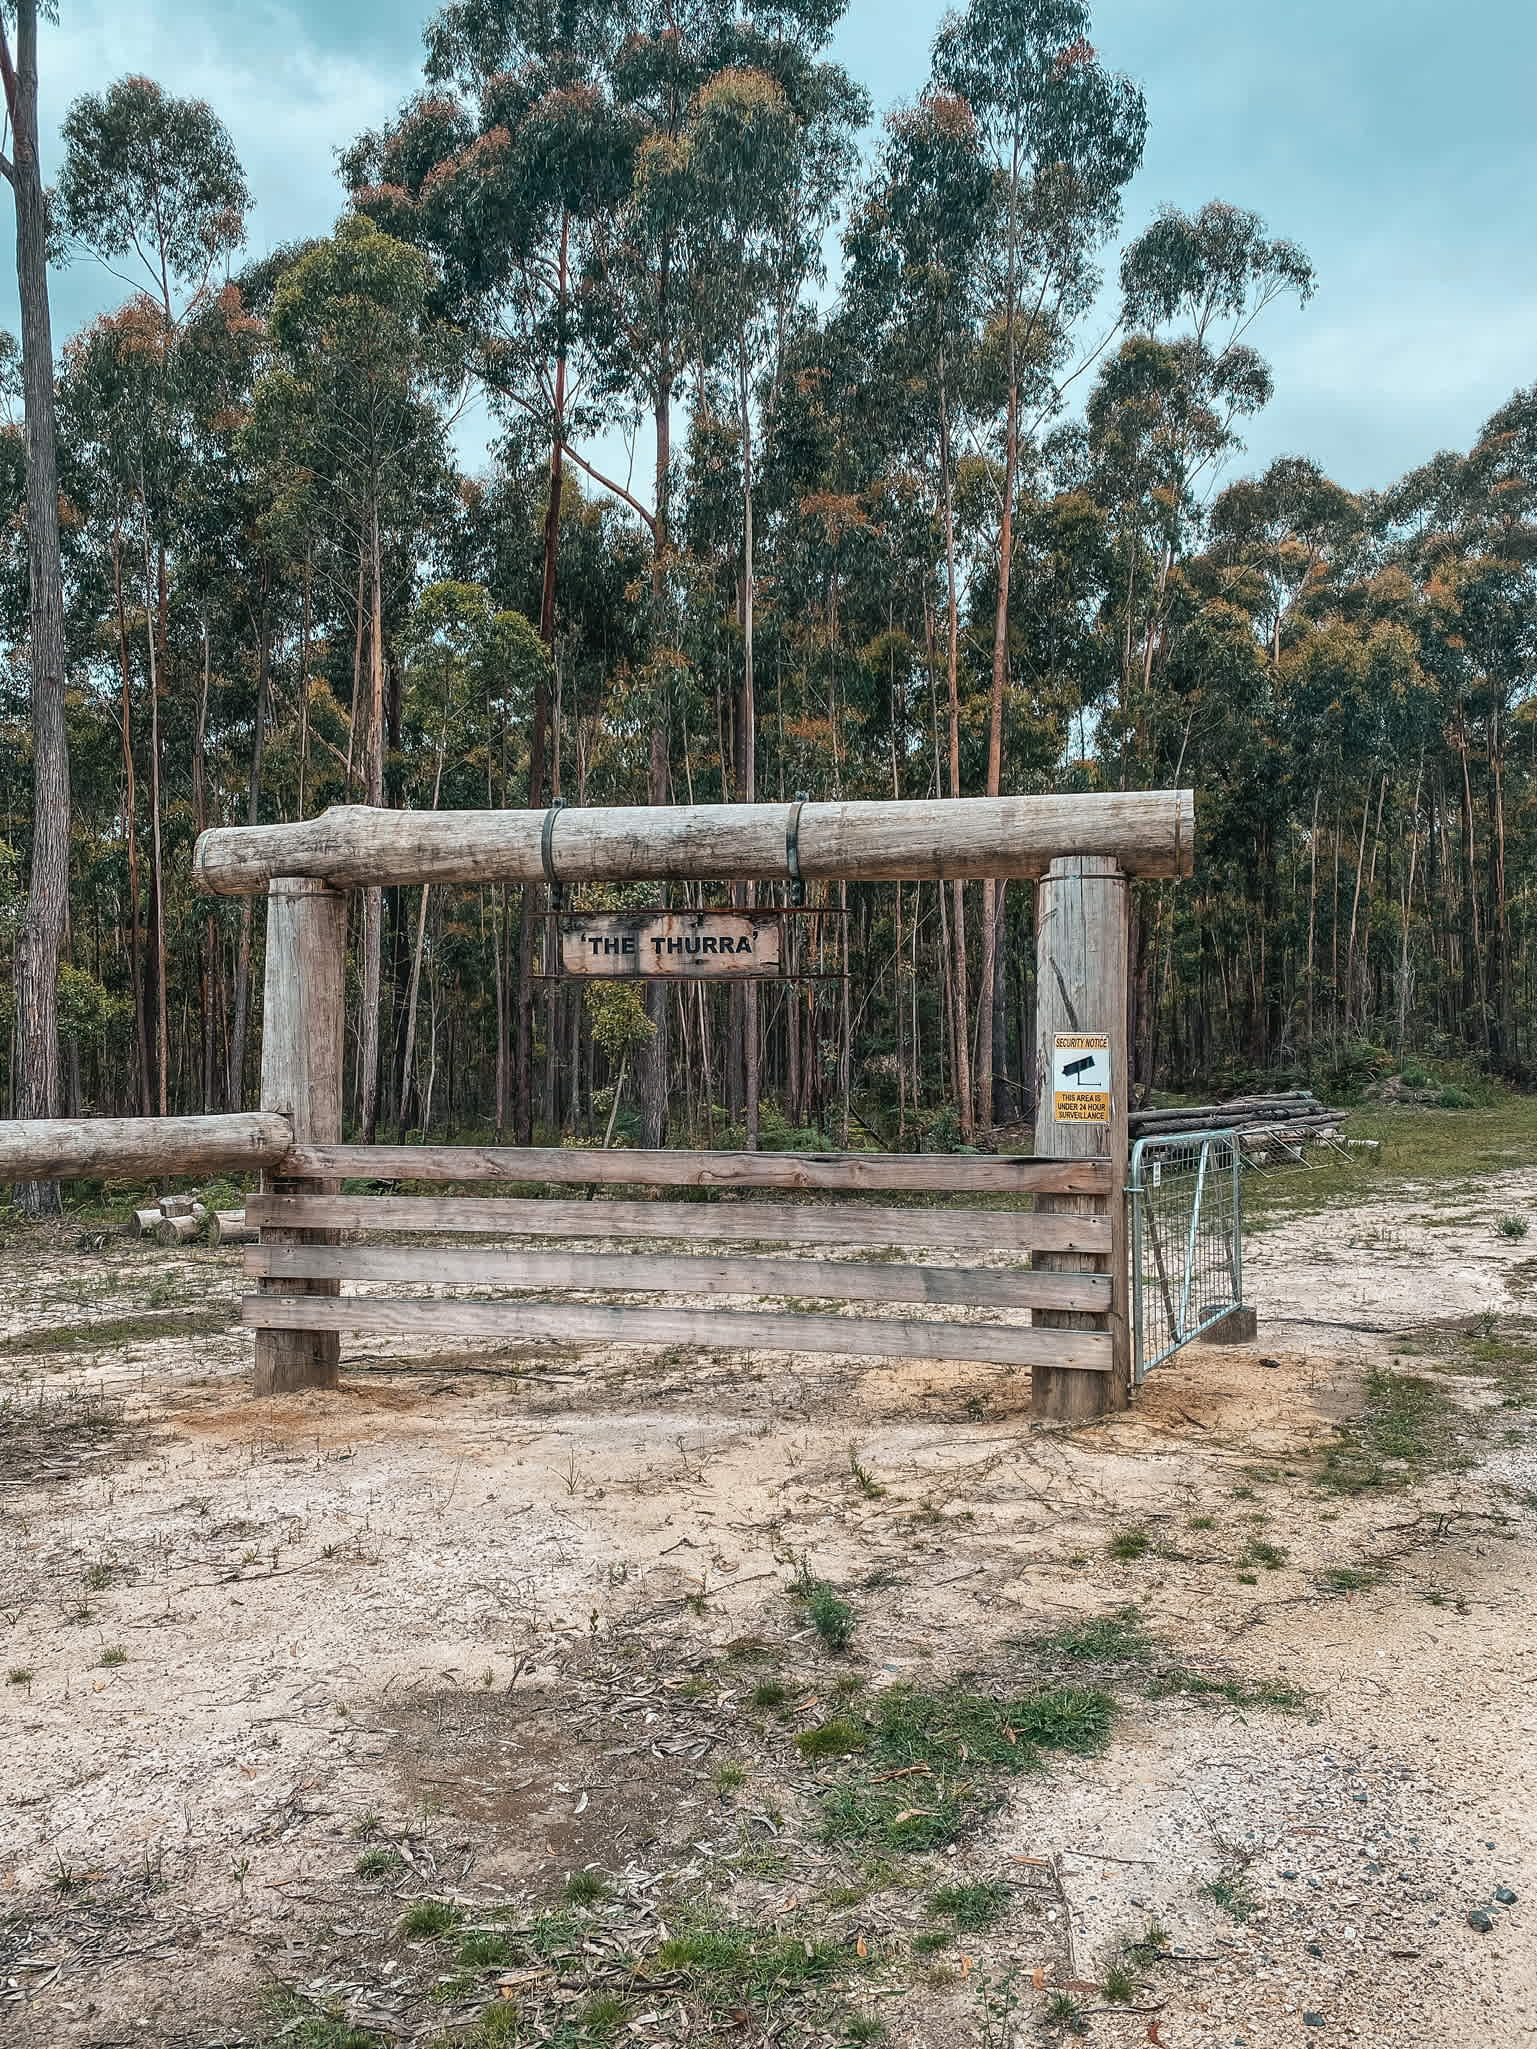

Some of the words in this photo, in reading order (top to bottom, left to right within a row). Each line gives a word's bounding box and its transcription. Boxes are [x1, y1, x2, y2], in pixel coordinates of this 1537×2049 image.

[1056, 1038, 1084, 1047] SECURITY
[1086, 1038, 1107, 1048] NOTICE
[1062, 1094, 1075, 1102] THIS
[1077, 1094, 1094, 1102] AREA
[1058, 1103, 1078, 1111] UNDER
[1079, 1103, 1087, 1111] 24
[1088, 1103, 1105, 1111] HOUR
